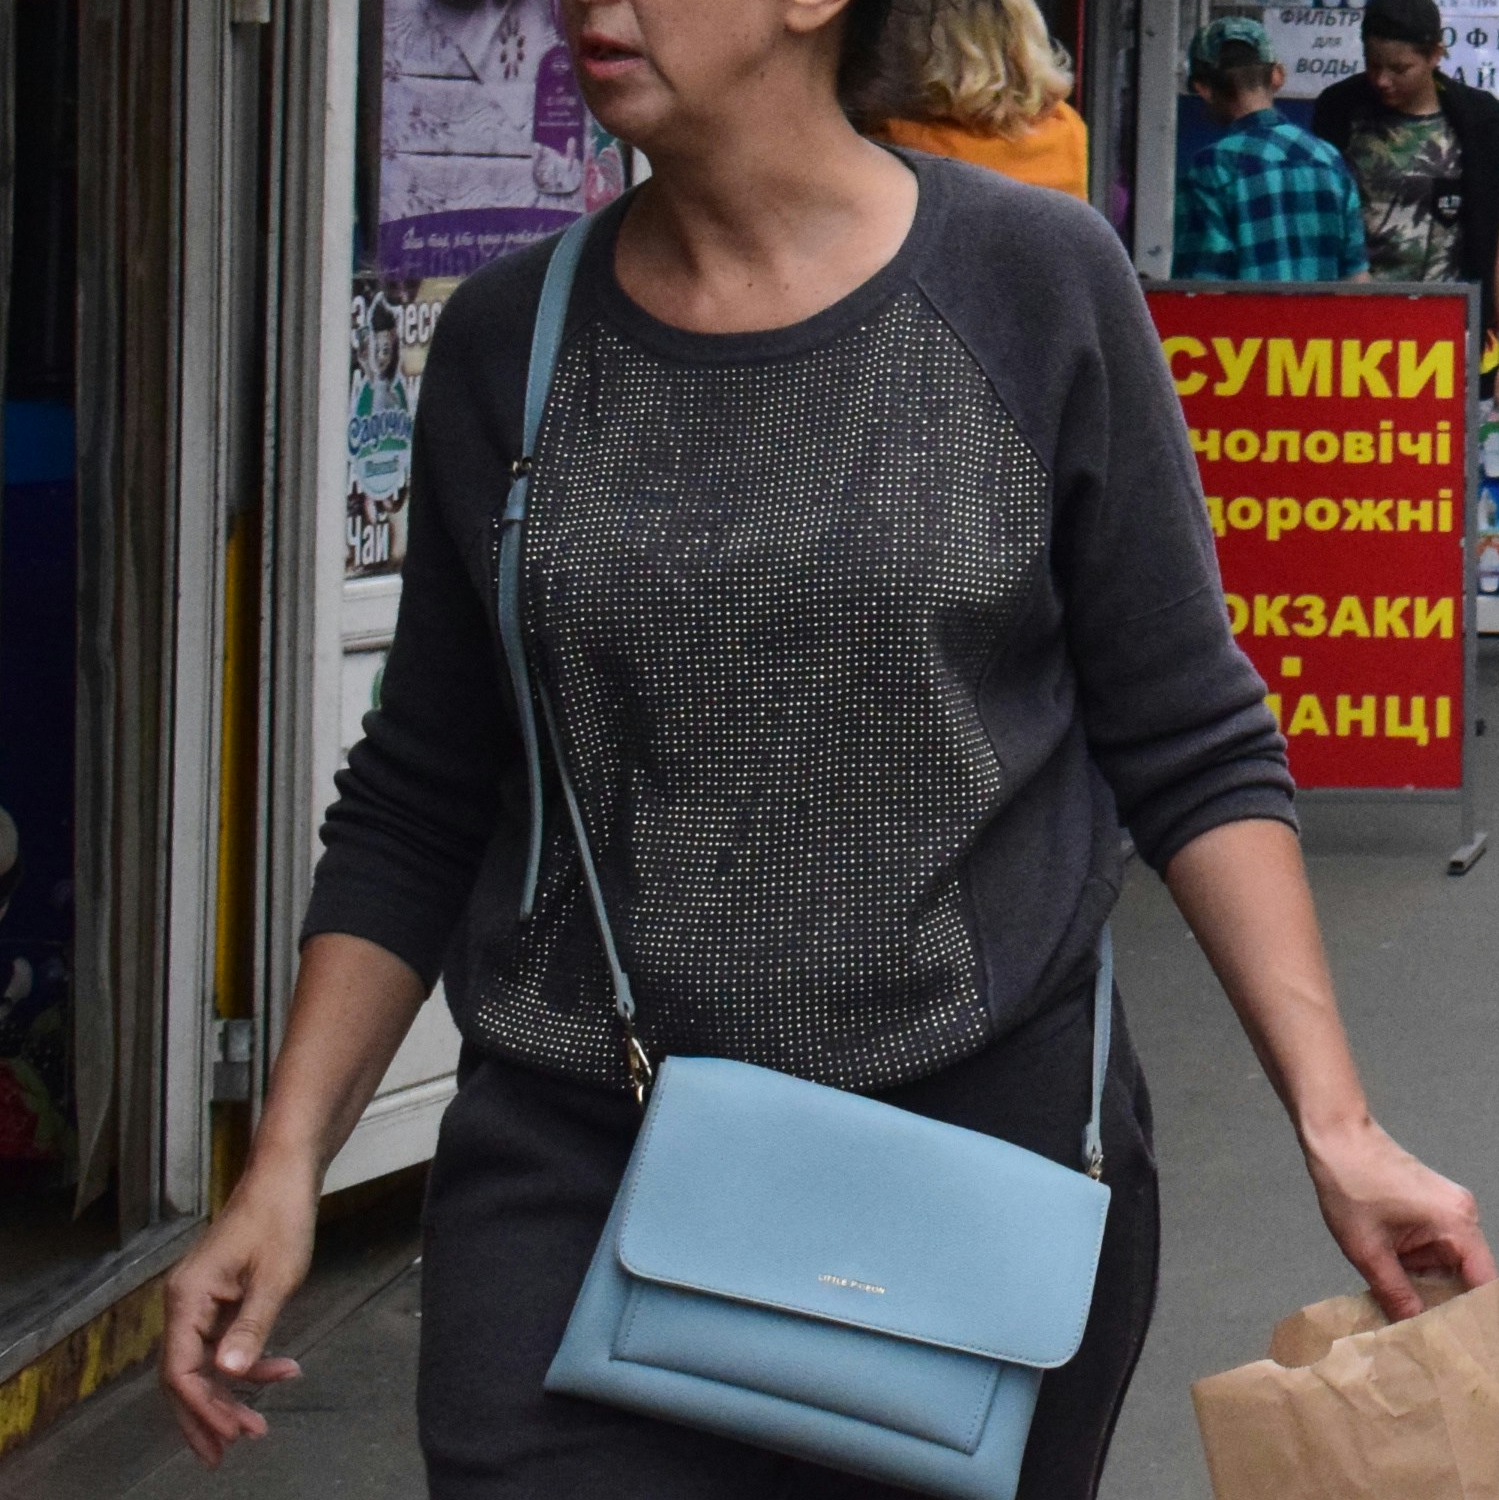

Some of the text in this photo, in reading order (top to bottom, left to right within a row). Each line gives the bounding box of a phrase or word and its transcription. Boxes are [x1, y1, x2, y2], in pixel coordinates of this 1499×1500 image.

[1280, 7, 1361, 27] ФИЛЬТР
[1295, 57, 1359, 78] ВОДЫ
[1159, 336, 1455, 400] СУМКИ
[1186, 420, 1451, 464] чоловічі
[1264, 694, 1450, 746] АНЦІ
